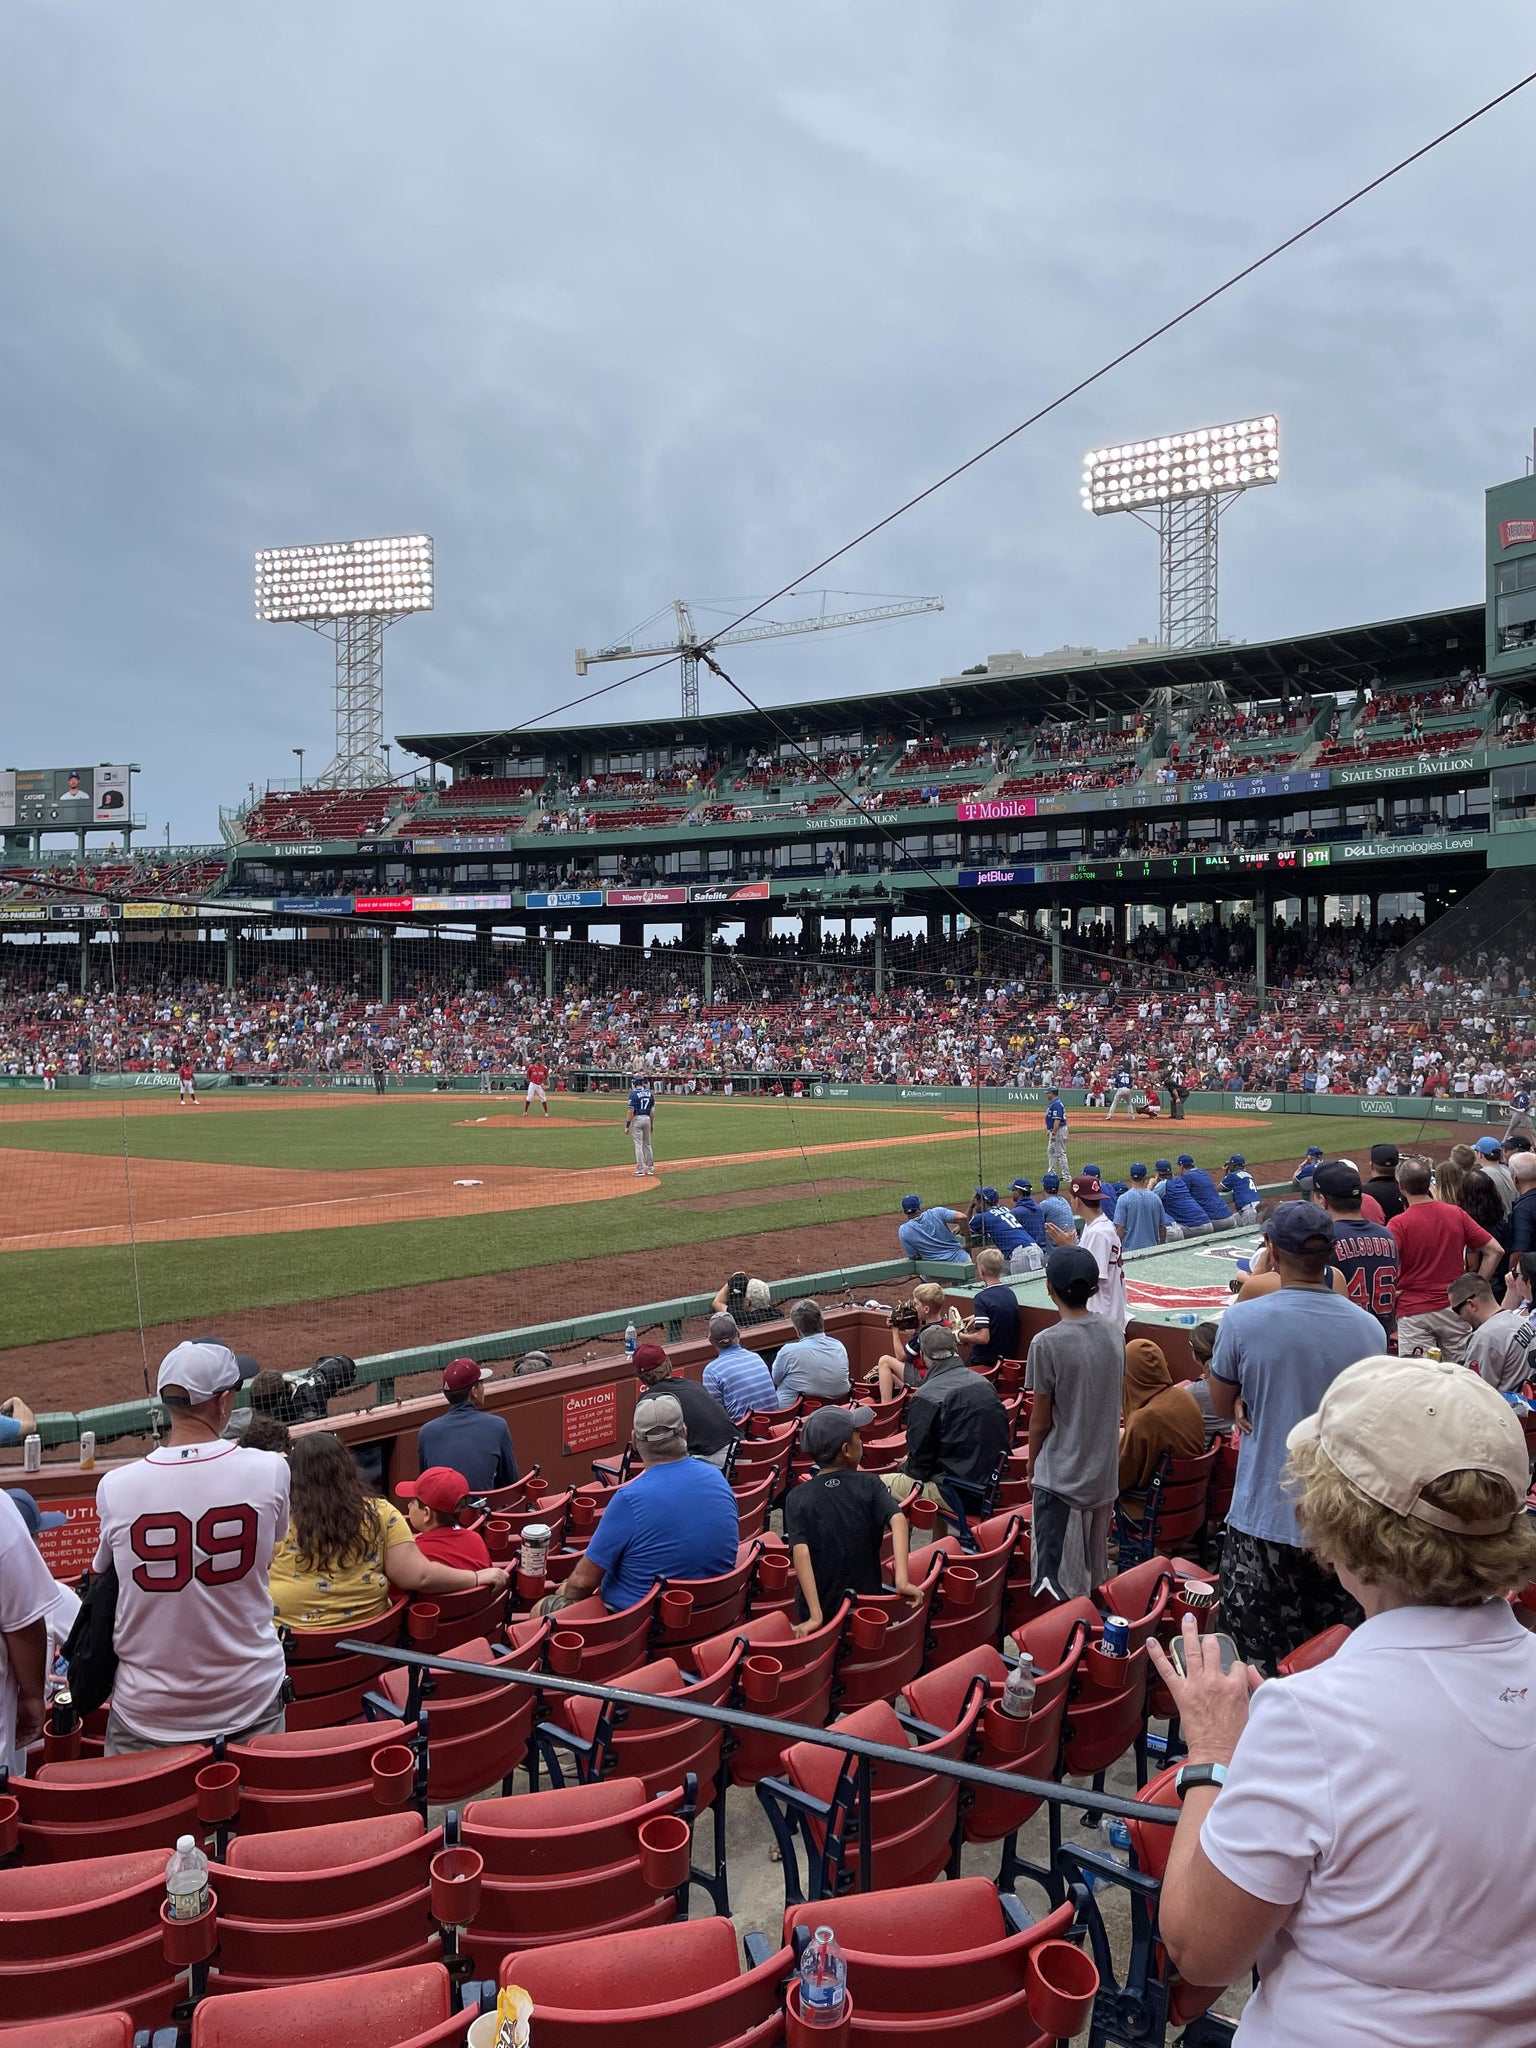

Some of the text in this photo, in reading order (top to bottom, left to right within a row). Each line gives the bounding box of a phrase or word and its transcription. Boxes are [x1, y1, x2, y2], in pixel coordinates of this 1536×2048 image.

[1341, 758, 1474, 783] STATE STREET PAVILION
[979, 801, 1027, 819] Mobile
[806, 814, 898, 829] STATE STREET PAVILION
[285, 845, 322, 855] UNITED
[1344, 837, 1474, 857] DELL Technologies Level
[1205, 857, 1230, 865] BALL
[1239, 853, 1270, 862] STRIKE
[1278, 851, 1296, 859] OUT
[1306, 851, 1329, 862] 9TH
[977, 871, 1015, 885] jetBlue
[1070, 872, 1096, 880] BOSTON
[558, 893, 581, 901] TUFTS
[622, 894, 643, 902] Ninety
[694, 893, 728, 901] Safelite
[1008, 1091, 1039, 1101] DASANI
[1234, 1096, 1256, 1104] Ninety
[640, 1098, 650, 1110] 17
[1234, 1102, 1256, 1110] Nine
[1360, 1101, 1395, 1113] WM
[1249, 1178, 1257, 1192] 4
[1000, 1212, 1023, 1228] 12
[1334, 1236, 1396, 1261] ELLSBURY
[1346, 1266, 1397, 1315] 46
[568, 1423, 612, 1438] OBJECTS LEAVING
[578, 1434, 598, 1444] PLAYING
[600, 1430, 613, 1438] FIELD
[38, 1531, 58, 1539] STAY
[61, 1527, 91, 1536] CLEAR
[40, 1540, 57, 1548] AND
[130, 1502, 258, 1592] 99
[42, 1548, 83, 1558] OBJECTS
